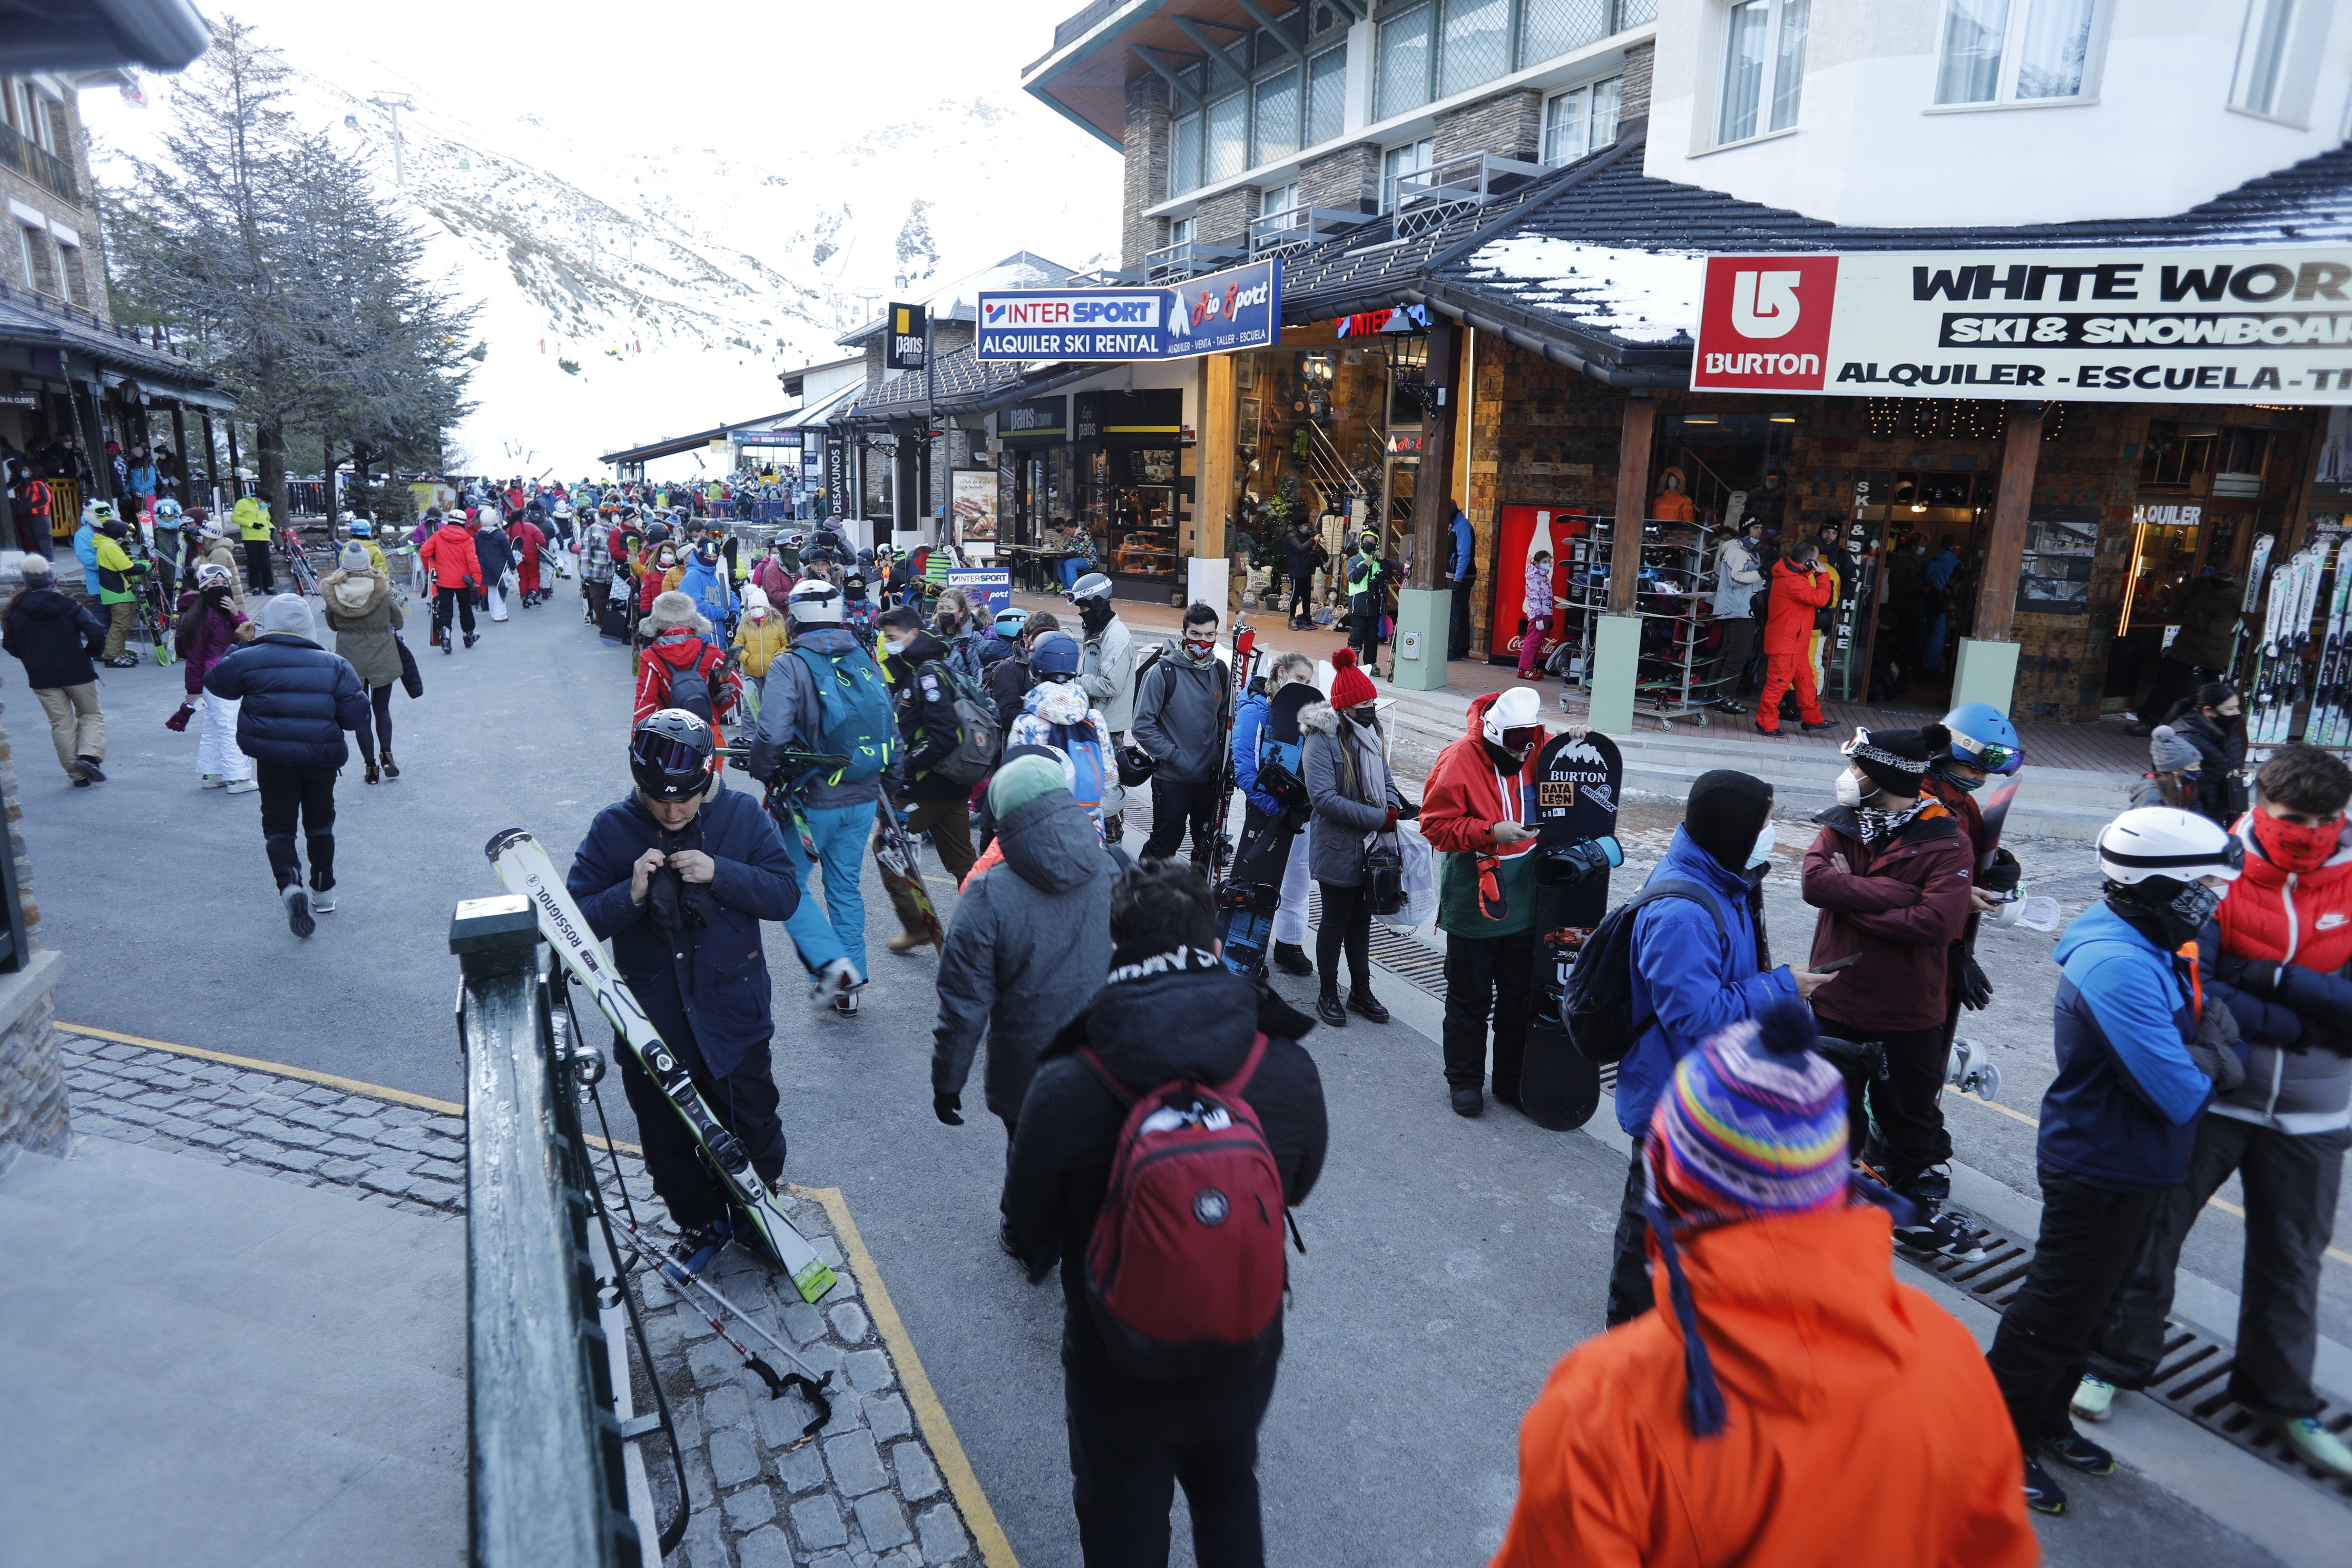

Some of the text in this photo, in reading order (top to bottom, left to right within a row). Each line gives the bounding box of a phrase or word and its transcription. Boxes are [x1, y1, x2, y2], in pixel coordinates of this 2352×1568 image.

[1913, 262, 2352, 302] WHITE WOR
[1191, 281, 1268, 326] Rio Sport
[1168, 342, 1191, 354] ALQUILER
[1194, 338, 1212, 350] VENTA
[1217, 334, 1235, 346] TALLER
[1240, 329, 1266, 342] ESCUELA
[1949, 317, 2030, 342] SKI
[2031, 317, 2069, 342] &
[896, 336, 923, 358] pans
[982, 335, 1159, 353] ALQUILER SKI RENTAL
[906, 354, 923, 365] COMPANY
[1704, 352, 1819, 376] BURTON
[1836, 362, 2046, 387] ALQUILER
[2076, 365, 2281, 390] ESCUELA
[1011, 408, 1034, 436] pans
[1079, 423, 1096, 440] pans
[831, 449, 841, 513] DESAYUNOS
[176, 531, 185, 568] FISCHER
[2246, 556, 2259, 612] FISCHER
[2285, 572, 2295, 623] FISCHER
[2302, 562, 2315, 621] FISCHER
[2269, 587, 2277, 630] FISCHER
[1837, 599, 1856, 649] HIRE
[1542, 784, 1572, 794] BATA
[1550, 771, 1606, 782] BURTON
[1582, 786, 1615, 811] SWITCHBACK
[536, 886, 583, 948] ROSSIGNOL
[584, 955, 593, 965] 163
[614, 1211, 631, 1226] TECNO
[661, 1269, 697, 1305] MONITOR TECNO
